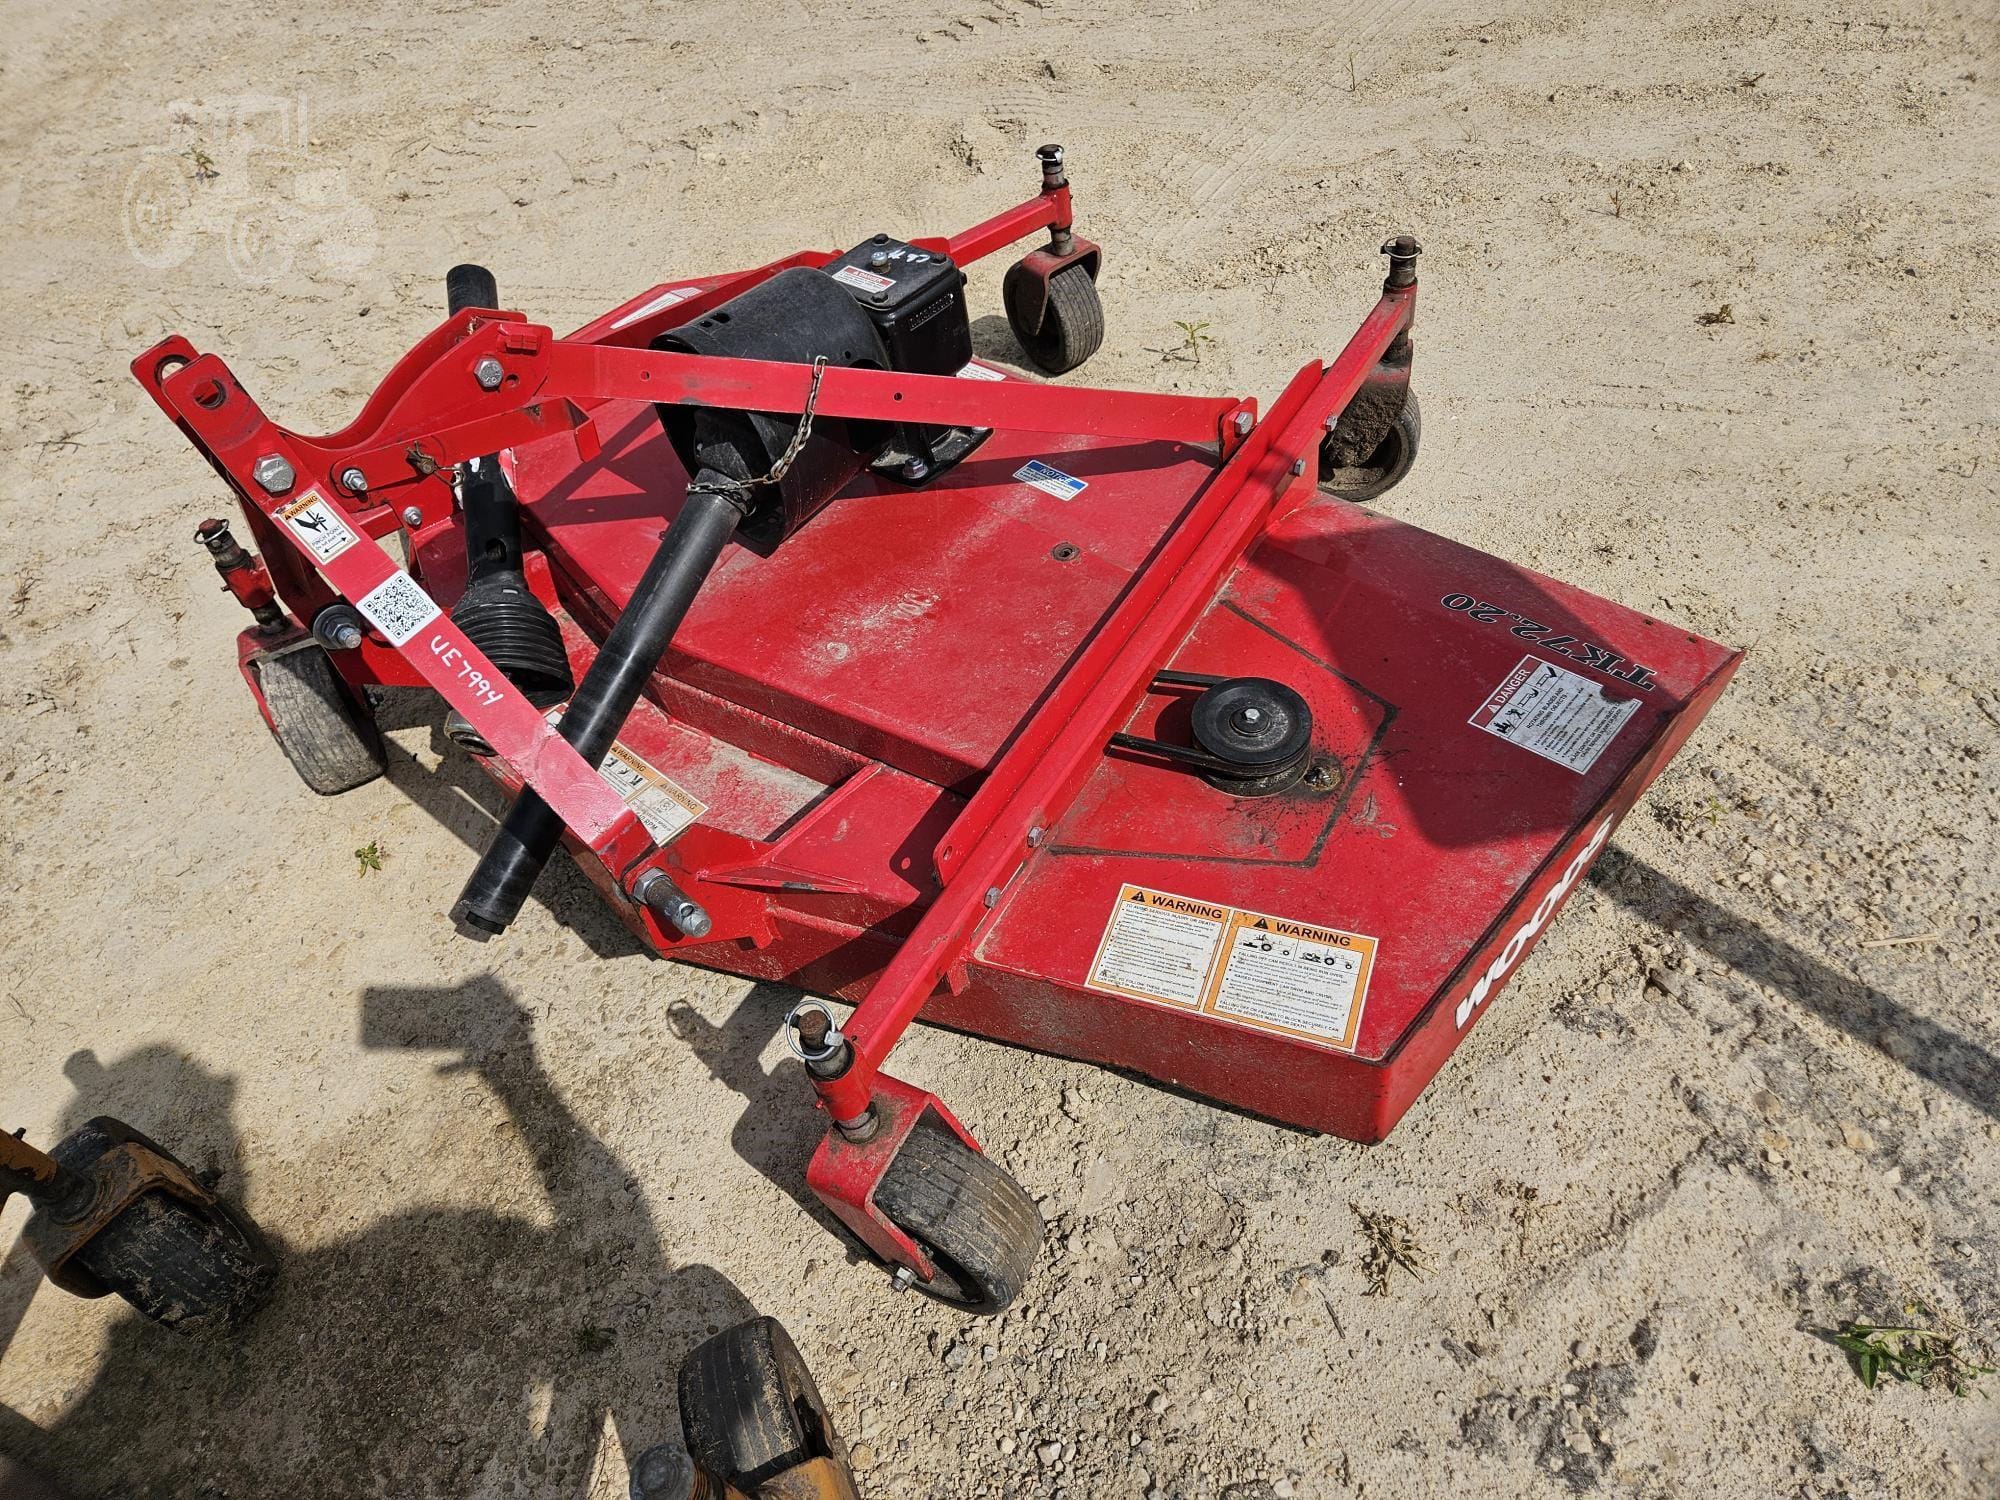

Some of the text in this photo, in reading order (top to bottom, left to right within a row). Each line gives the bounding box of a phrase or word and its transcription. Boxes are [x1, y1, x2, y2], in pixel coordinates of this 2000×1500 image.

[1039, 467, 1072, 484] NOTICE
[288, 495, 318, 516] WARNING
[311, 534, 327, 547] PINCH
[325, 524, 341, 537] POINT
[1441, 593, 1656, 691] TK72.20
[430, 634, 504, 706] UE7994
[1494, 668, 1531, 703] DANGER
[616, 749, 646, 772] WARNING
[1151, 894, 1223, 920] WARNING
[1274, 922, 1351, 946] WARNING
[1455, 814, 1613, 1029] WOODS
